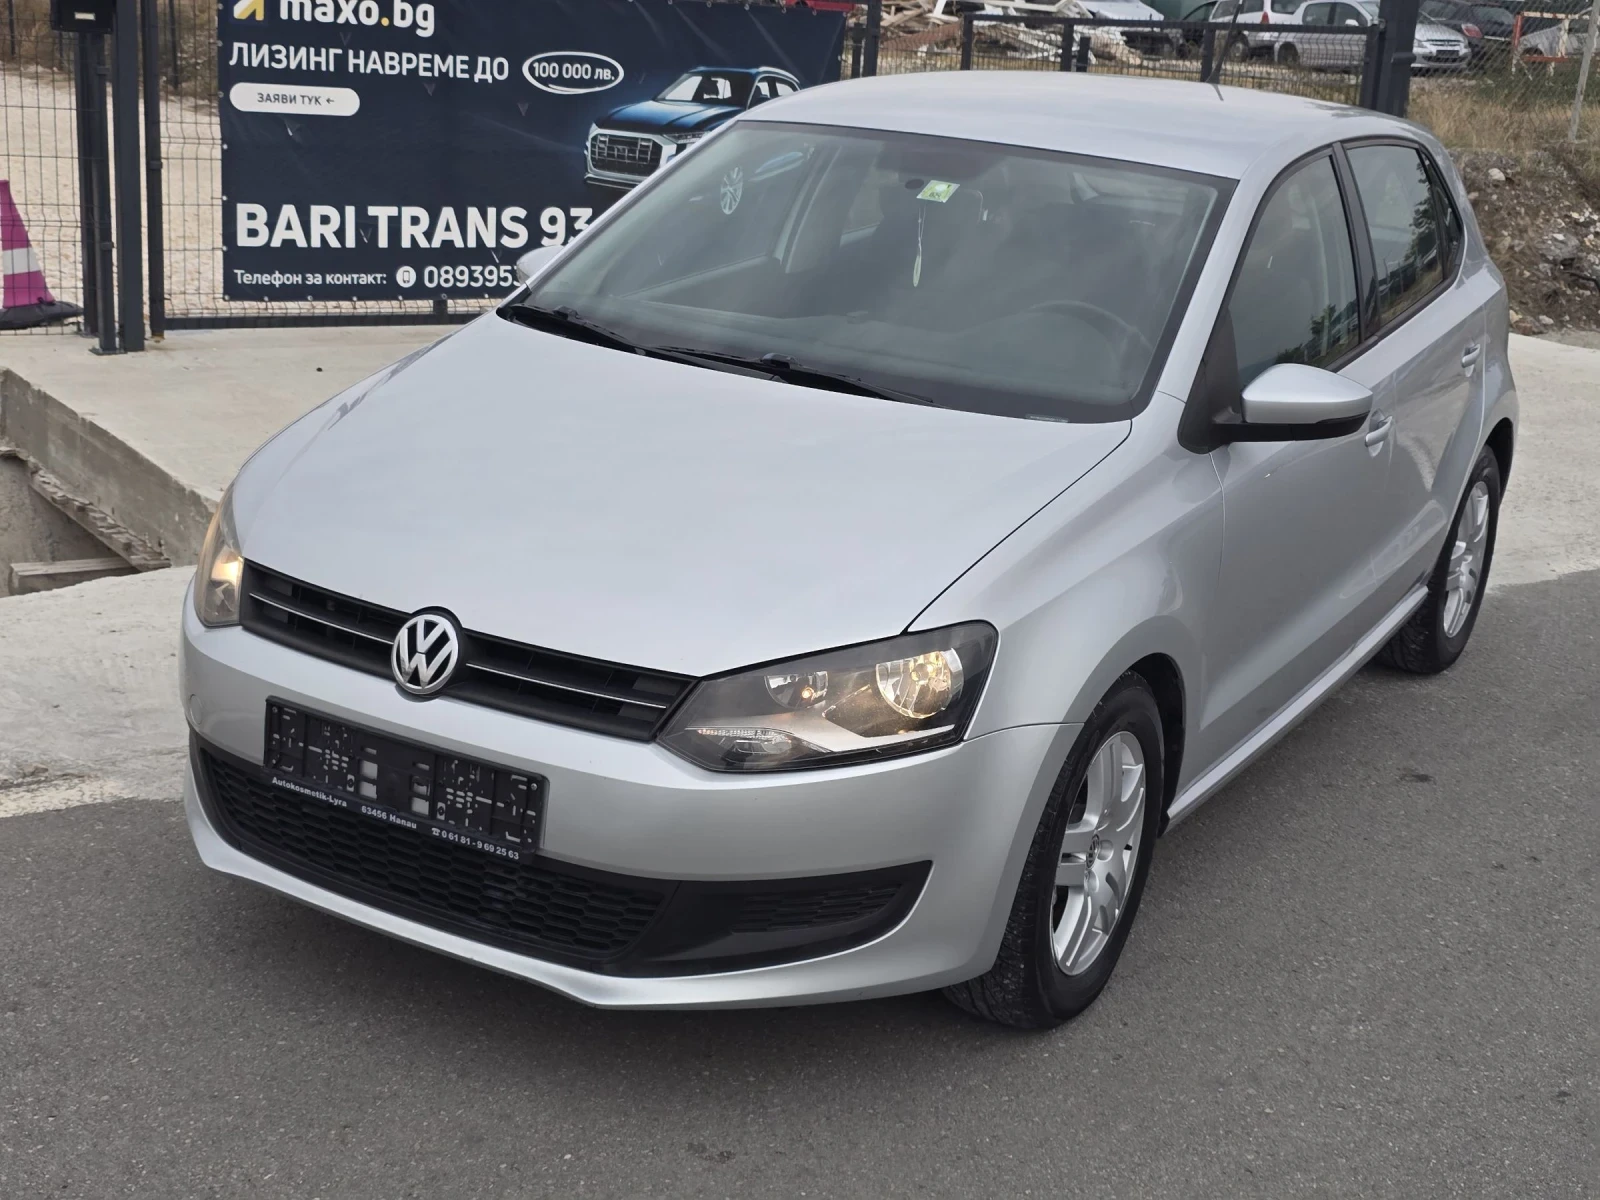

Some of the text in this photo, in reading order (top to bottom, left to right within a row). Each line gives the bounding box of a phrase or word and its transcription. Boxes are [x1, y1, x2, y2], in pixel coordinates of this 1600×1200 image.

[279, 0, 435, 38] maxo.bg
[229, 41, 615, 83] ЛИЗИНГ НАВРЕМЕ ДО 100 000 лв.
[257, 92, 322, 106] ЗАЯВИ ТУК
[236, 203, 356, 248] BARI
[367, 206, 529, 249] TRANS
[233, 269, 302, 288] Телефон
[305, 273, 323, 285] за
[325, 272, 388, 286] контакт:
[272, 776, 347, 808] Autokosmetik-Lyra
[361, 805, 388, 820] 63456
[389, 814, 417, 829] Hanau
